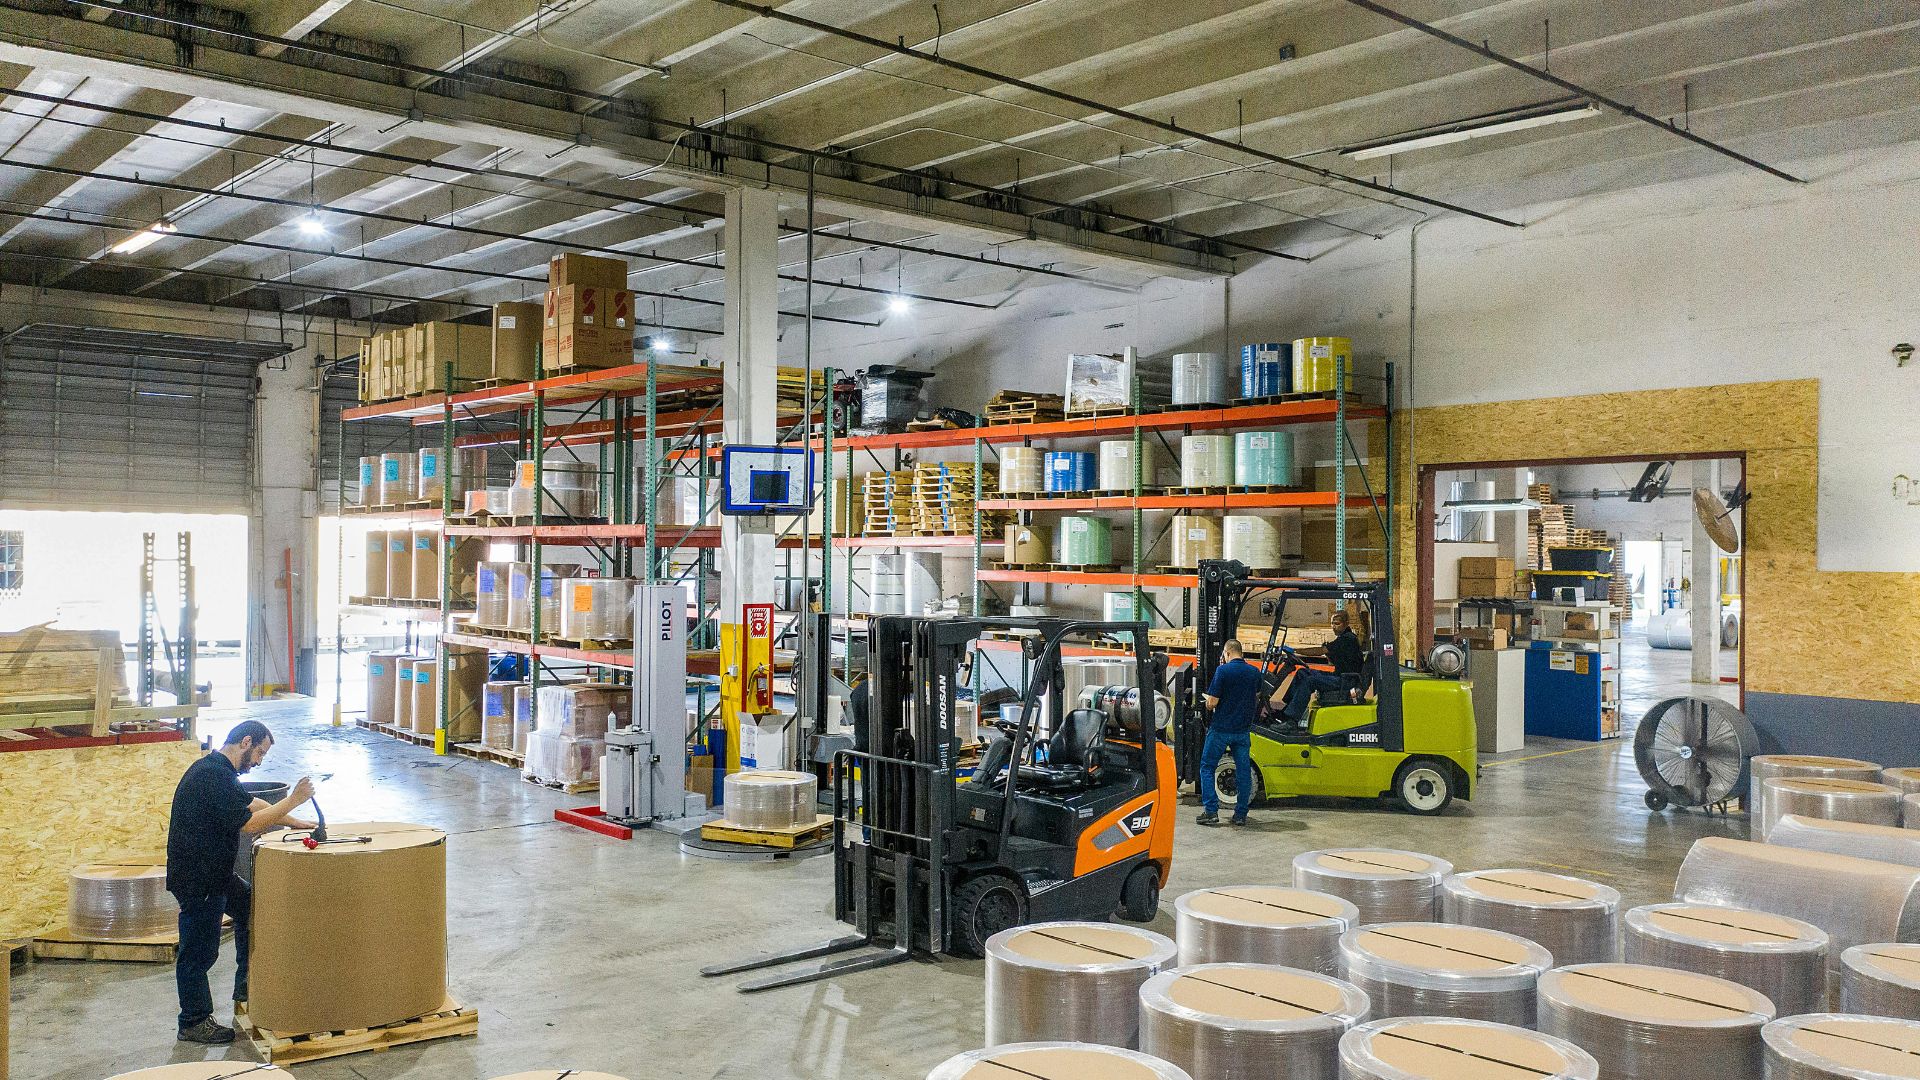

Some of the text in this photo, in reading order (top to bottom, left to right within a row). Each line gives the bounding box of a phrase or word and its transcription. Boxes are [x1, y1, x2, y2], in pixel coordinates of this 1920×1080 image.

[661, 600, 672, 641] PILOT
[1208, 605, 1218, 634] CLARK
[939, 674, 947, 730] DOOSAN
[1349, 733, 1379, 743] CLARK
[1130, 816, 1152, 831] 30
